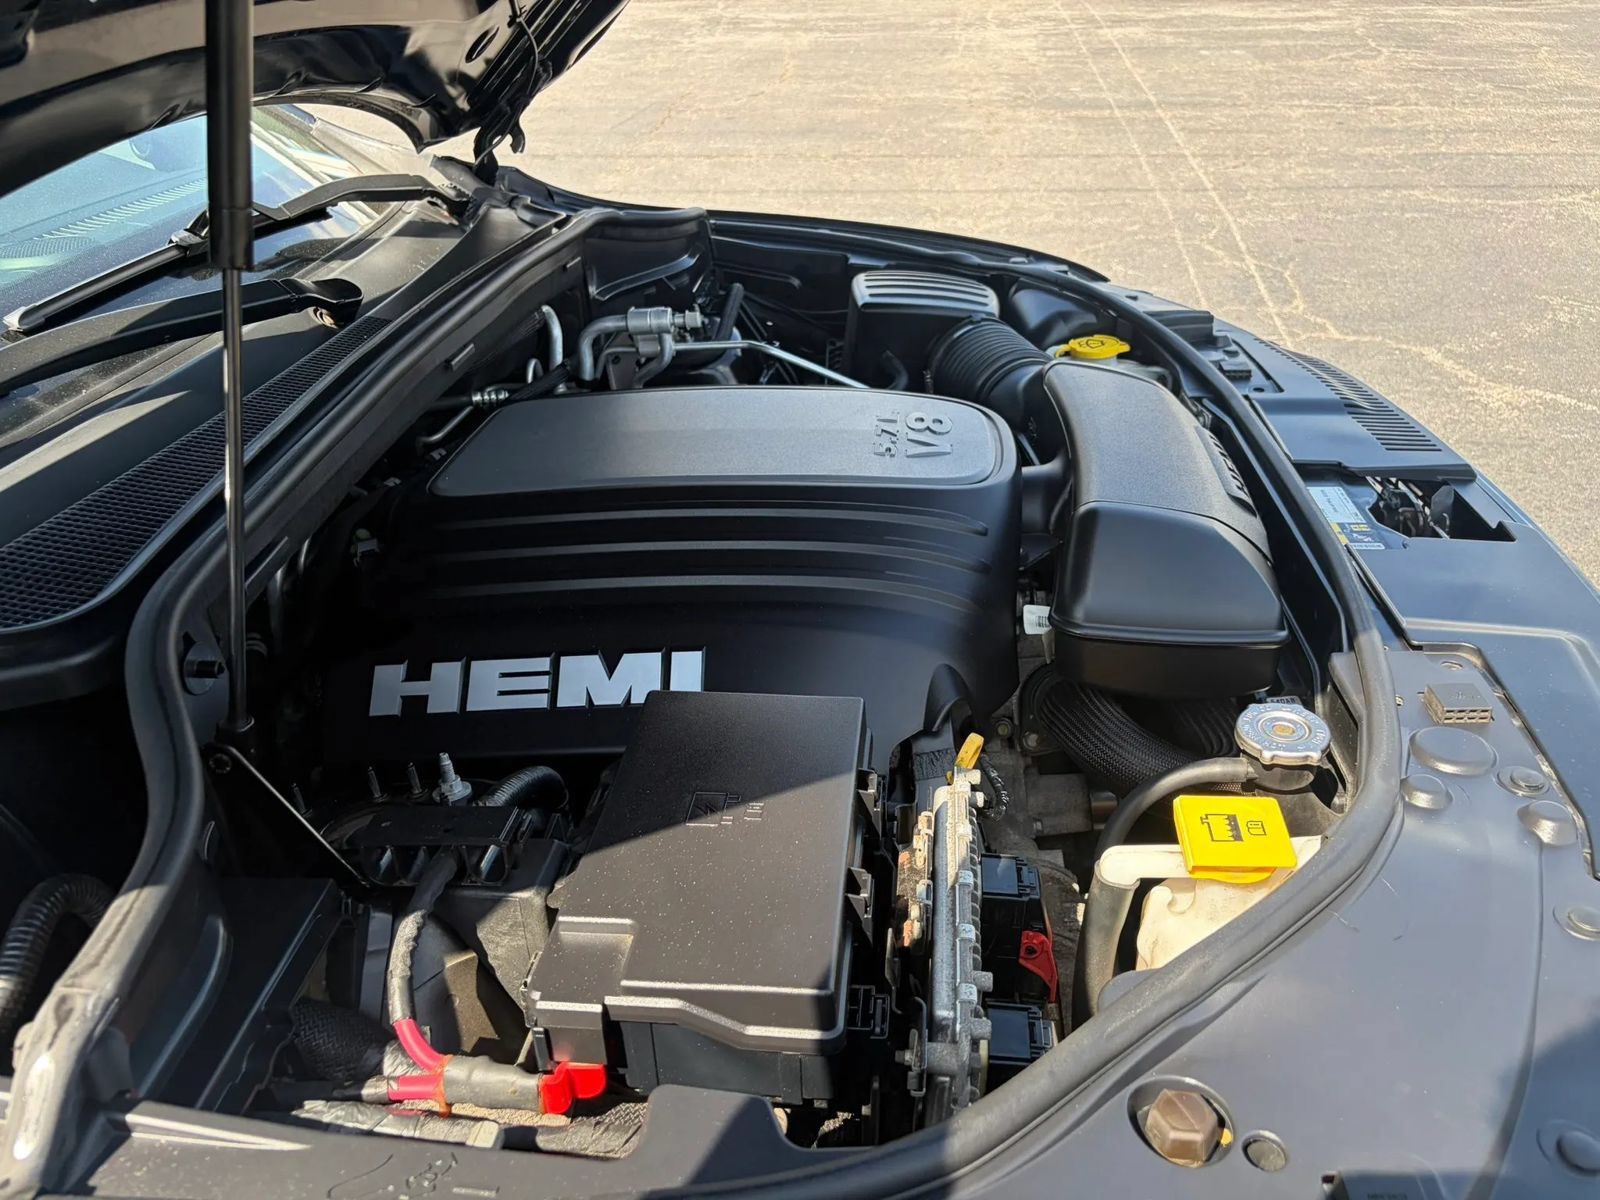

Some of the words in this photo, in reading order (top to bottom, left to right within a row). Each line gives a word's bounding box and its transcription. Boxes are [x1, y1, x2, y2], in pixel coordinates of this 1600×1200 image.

[873, 410, 900, 458] 5.7L
[905, 411, 953, 459] V8
[368, 646, 706, 717] HEMI
